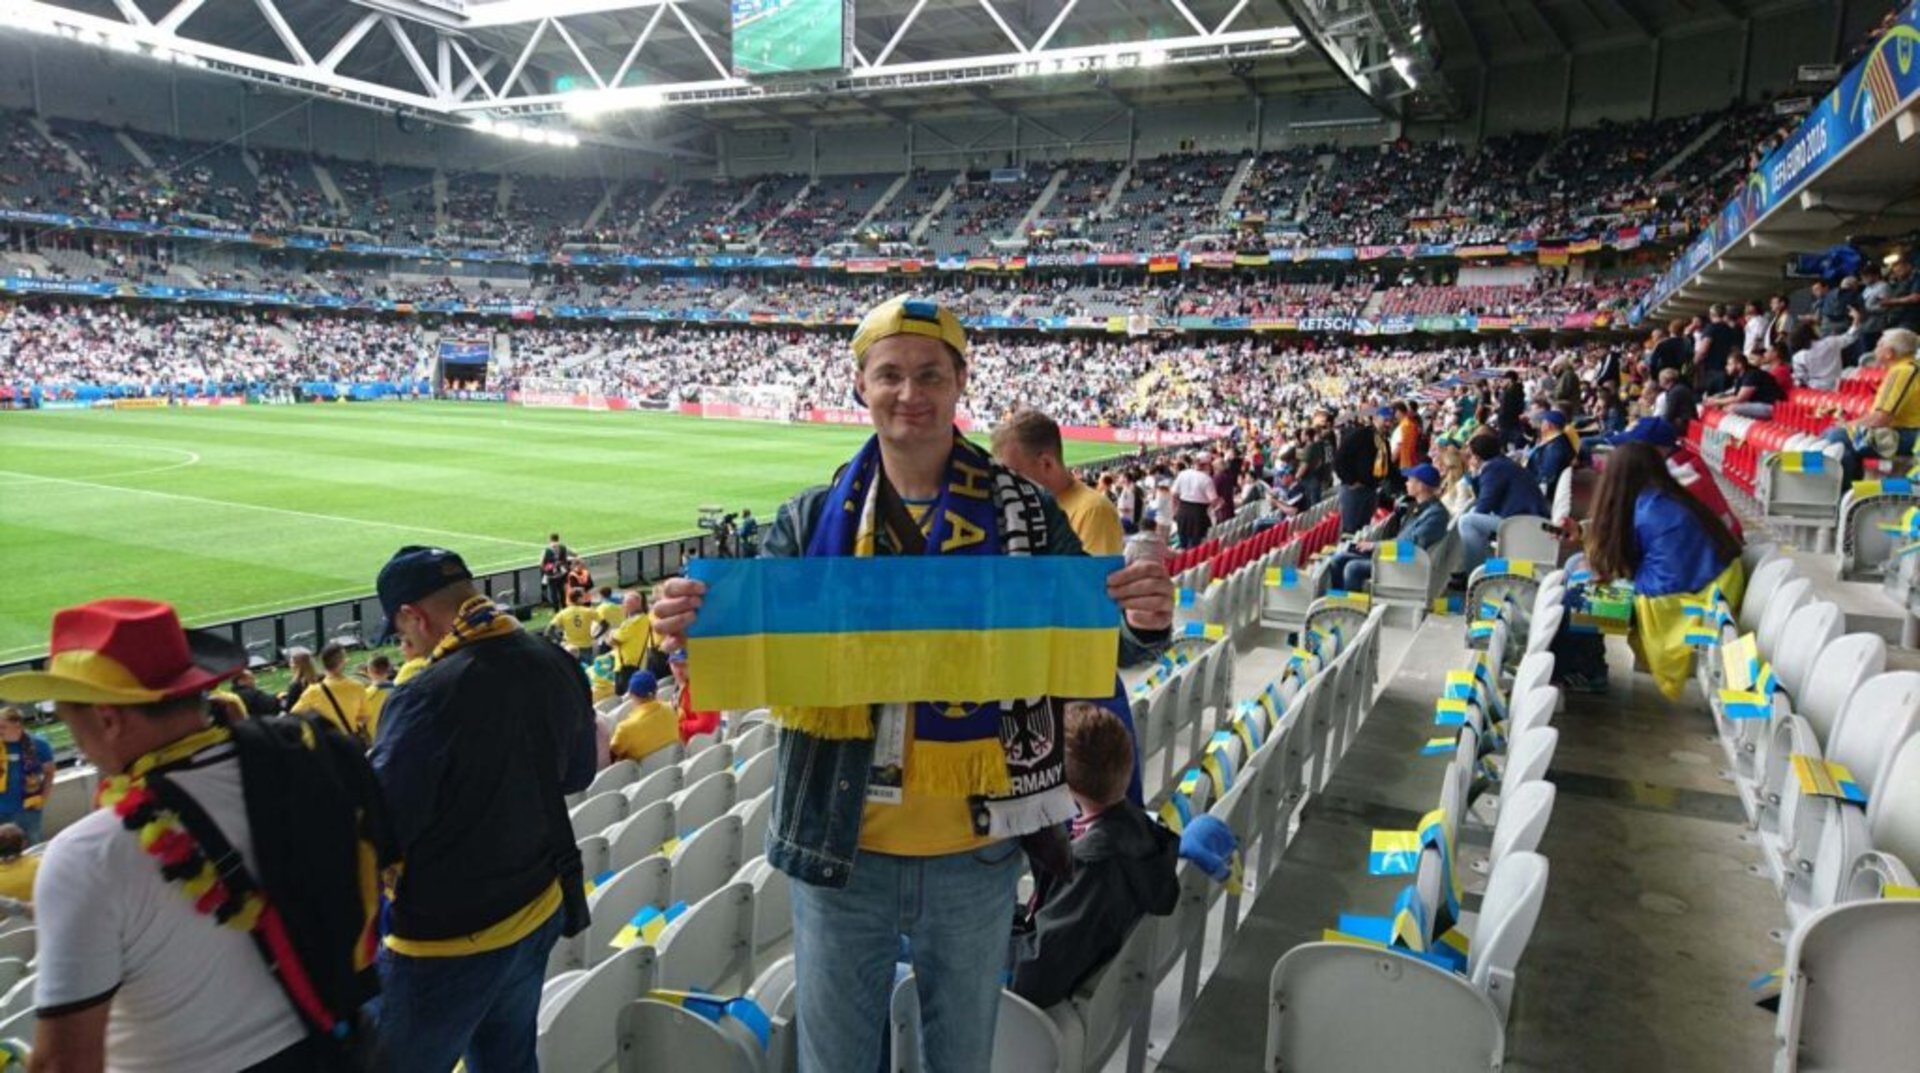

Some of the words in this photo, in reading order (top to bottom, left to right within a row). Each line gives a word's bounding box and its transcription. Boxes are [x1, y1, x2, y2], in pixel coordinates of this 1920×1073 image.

[1787, 138, 1807, 180] EURO
[1806, 117, 1828, 163] 2016
[1298, 317, 1352, 331] KETSCH
[1019, 482, 1048, 547] LILLE
[573, 615, 582, 628] 6
